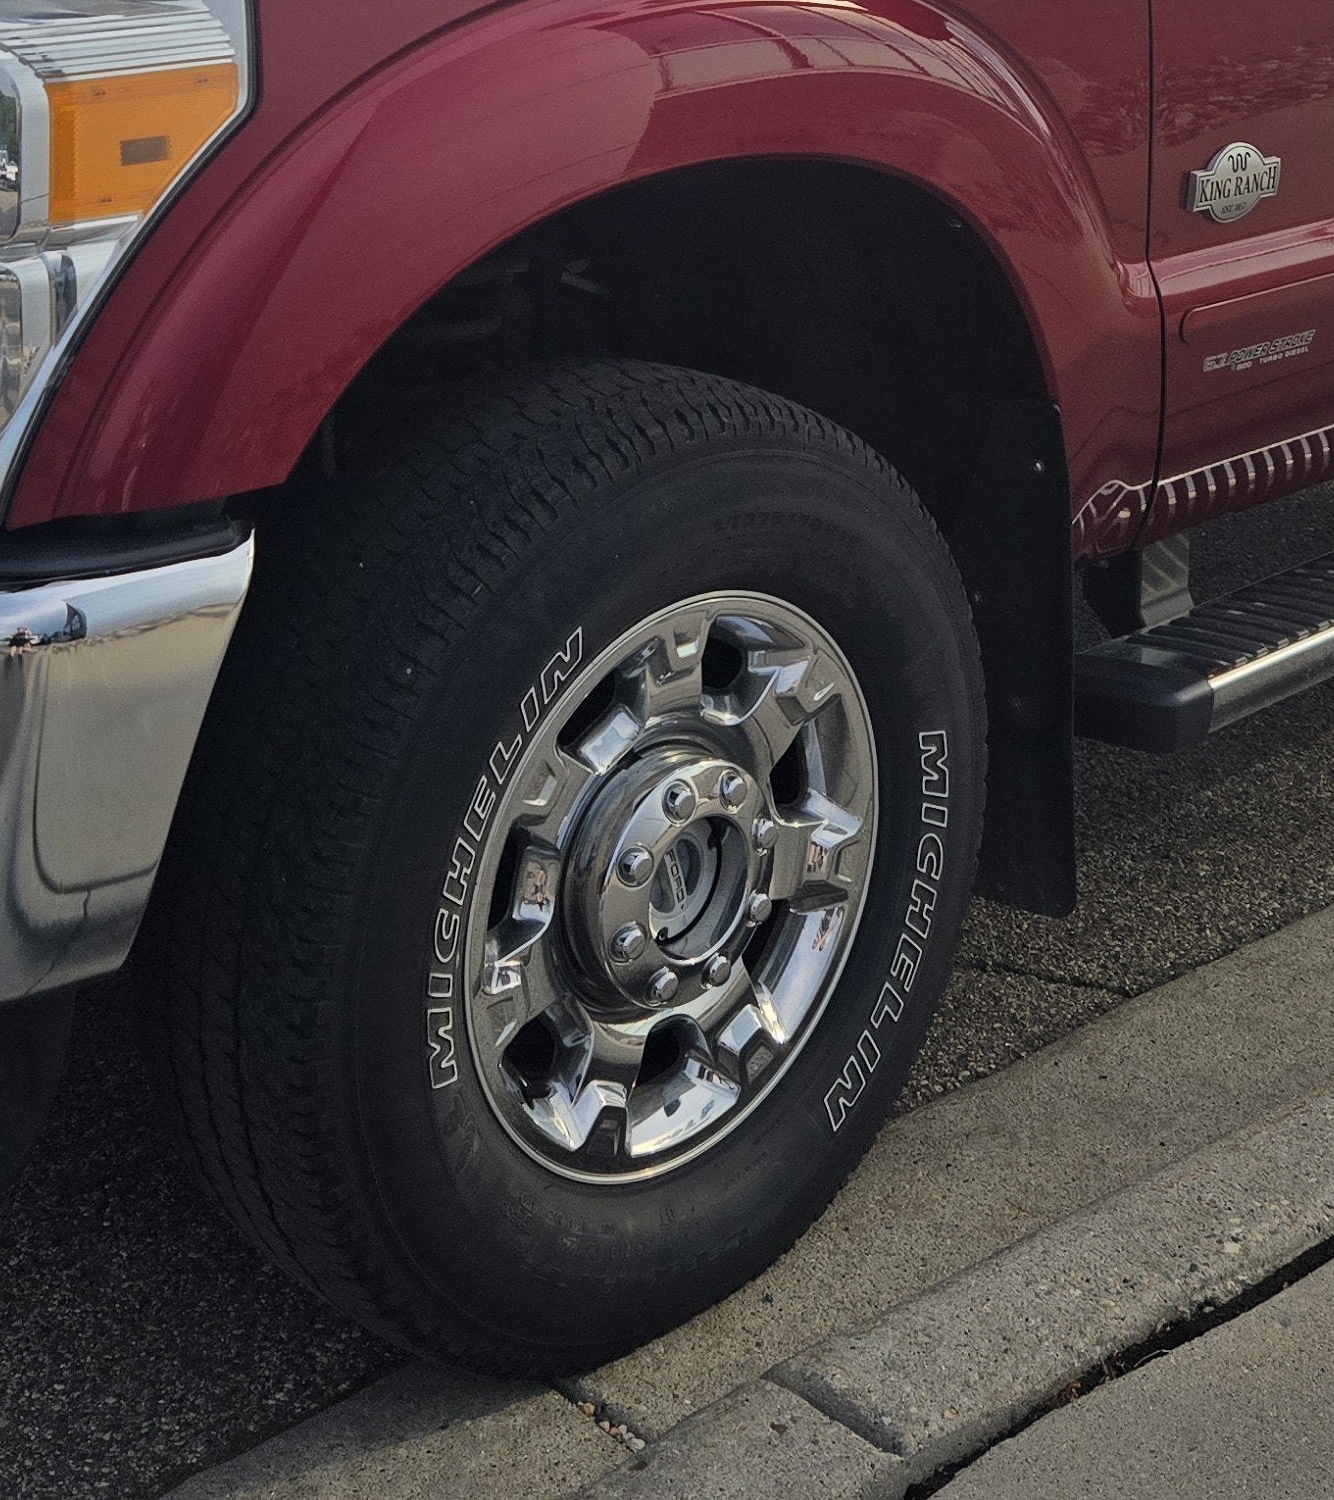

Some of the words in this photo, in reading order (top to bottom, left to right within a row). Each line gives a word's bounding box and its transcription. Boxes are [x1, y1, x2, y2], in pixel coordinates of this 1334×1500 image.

[1199, 178, 1232, 203] KING
[1234, 166, 1277, 197] RANCH
[1227, 341, 1271, 366] POWER
[426, 626, 584, 1090] MICHELIN
[666, 847, 686, 904] FORD
[821, 729, 950, 1132] MICHELIN
